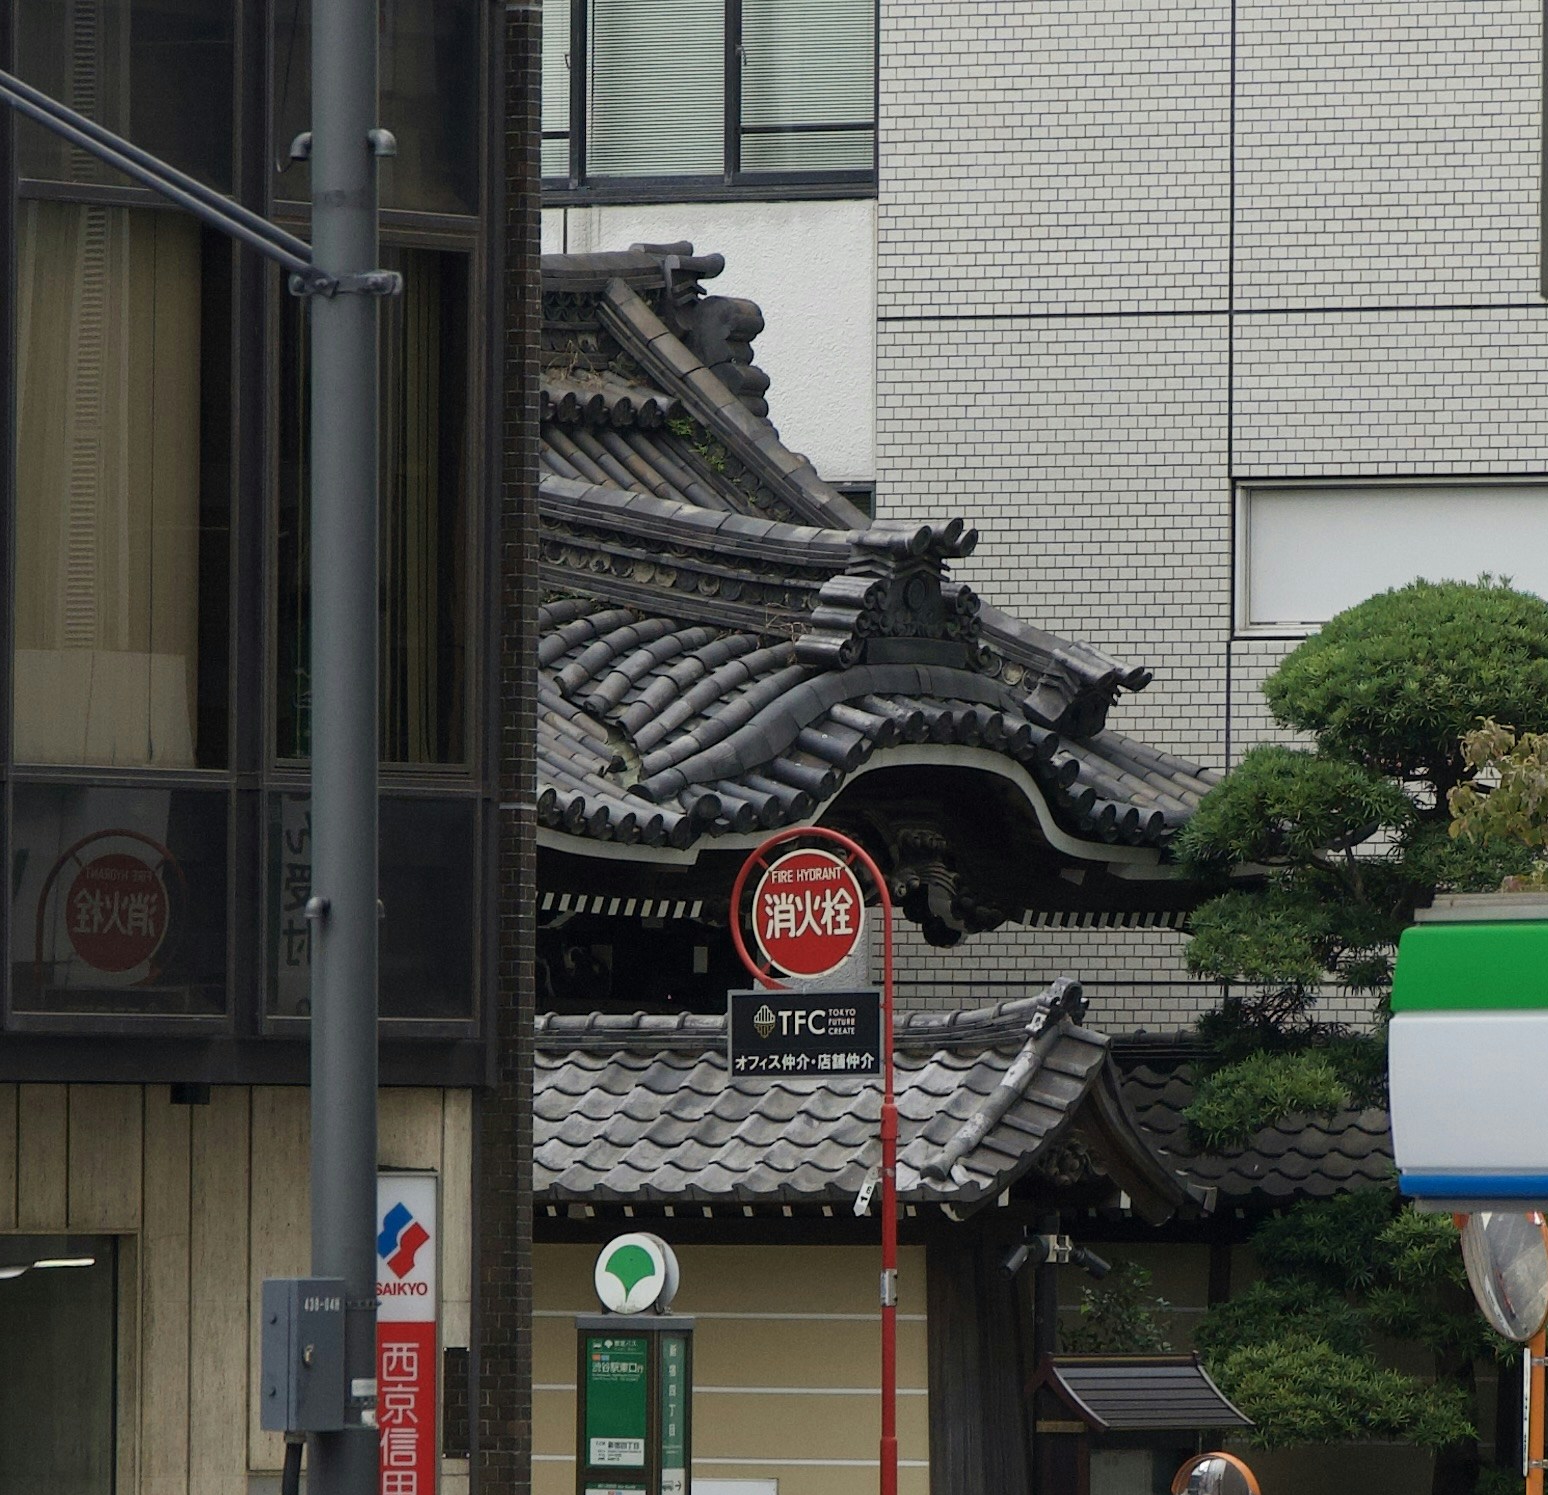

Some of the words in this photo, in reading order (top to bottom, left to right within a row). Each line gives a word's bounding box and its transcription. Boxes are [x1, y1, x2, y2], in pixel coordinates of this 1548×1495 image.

[771, 869, 793, 884] FIRE
[797, 866, 841, 882] HYDRANT
[764, 887, 853, 939] 消火栓
[828, 1008, 856, 1017] TOKYO
[778, 1010, 826, 1036] TFC
[828, 1027, 855, 1036] CREATE
[376, 1282, 428, 1296] SAIKYO
